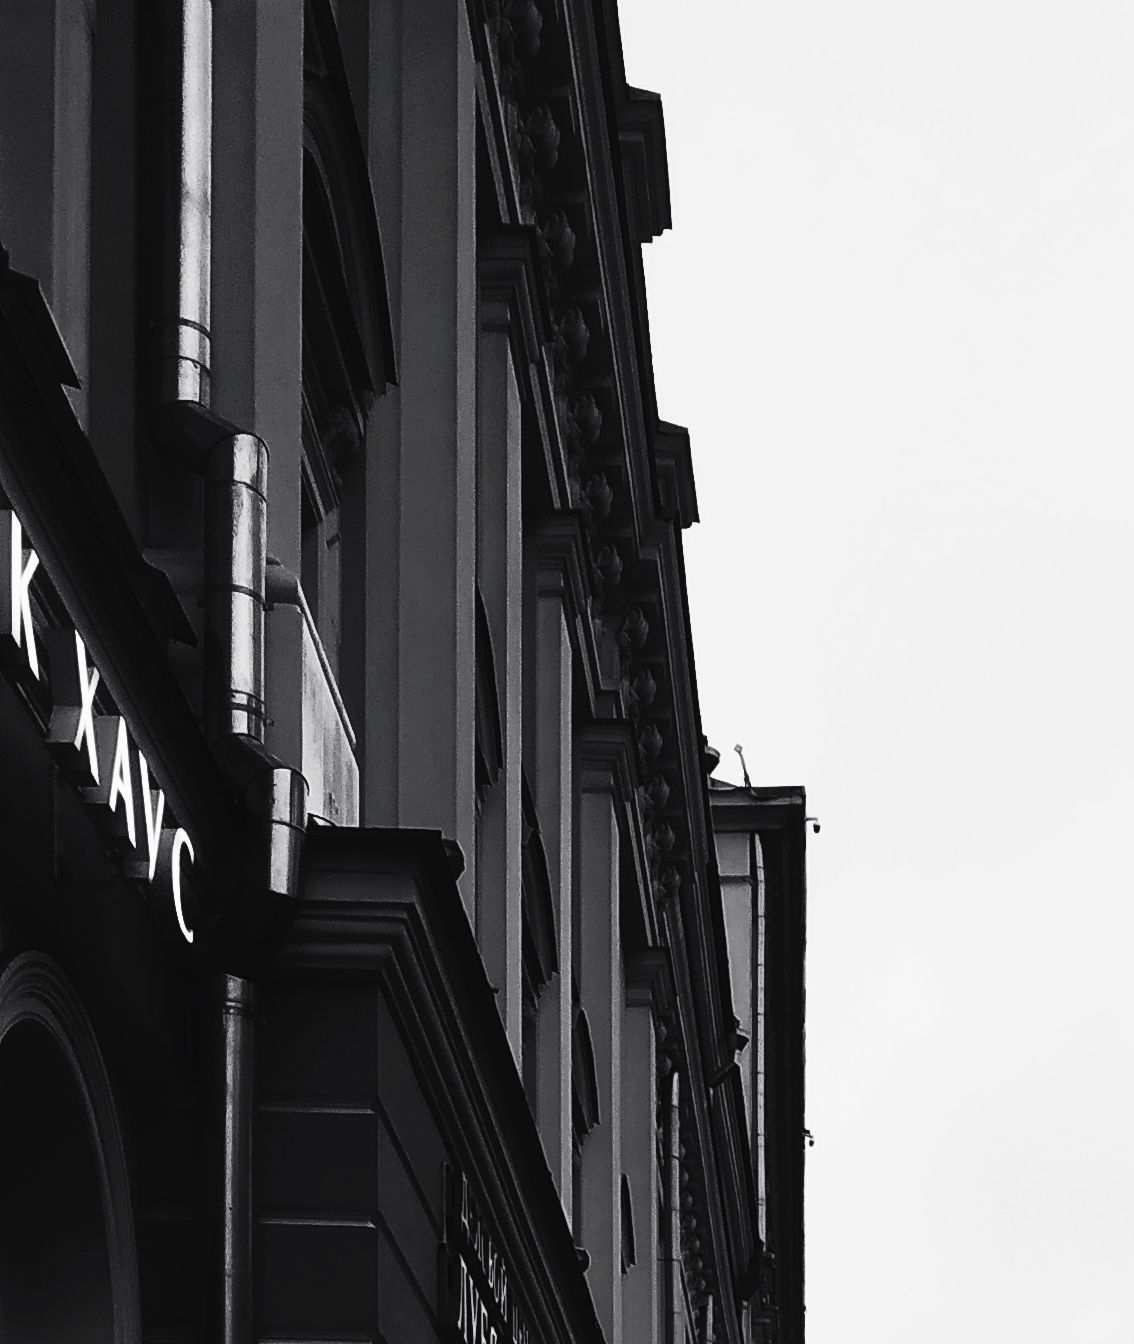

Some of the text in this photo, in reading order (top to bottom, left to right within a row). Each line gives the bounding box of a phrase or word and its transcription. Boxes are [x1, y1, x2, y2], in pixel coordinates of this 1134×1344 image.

[11, 509, 195, 944] К ХАУС
[461, 1171, 508, 1322] ДЛВОЙ
